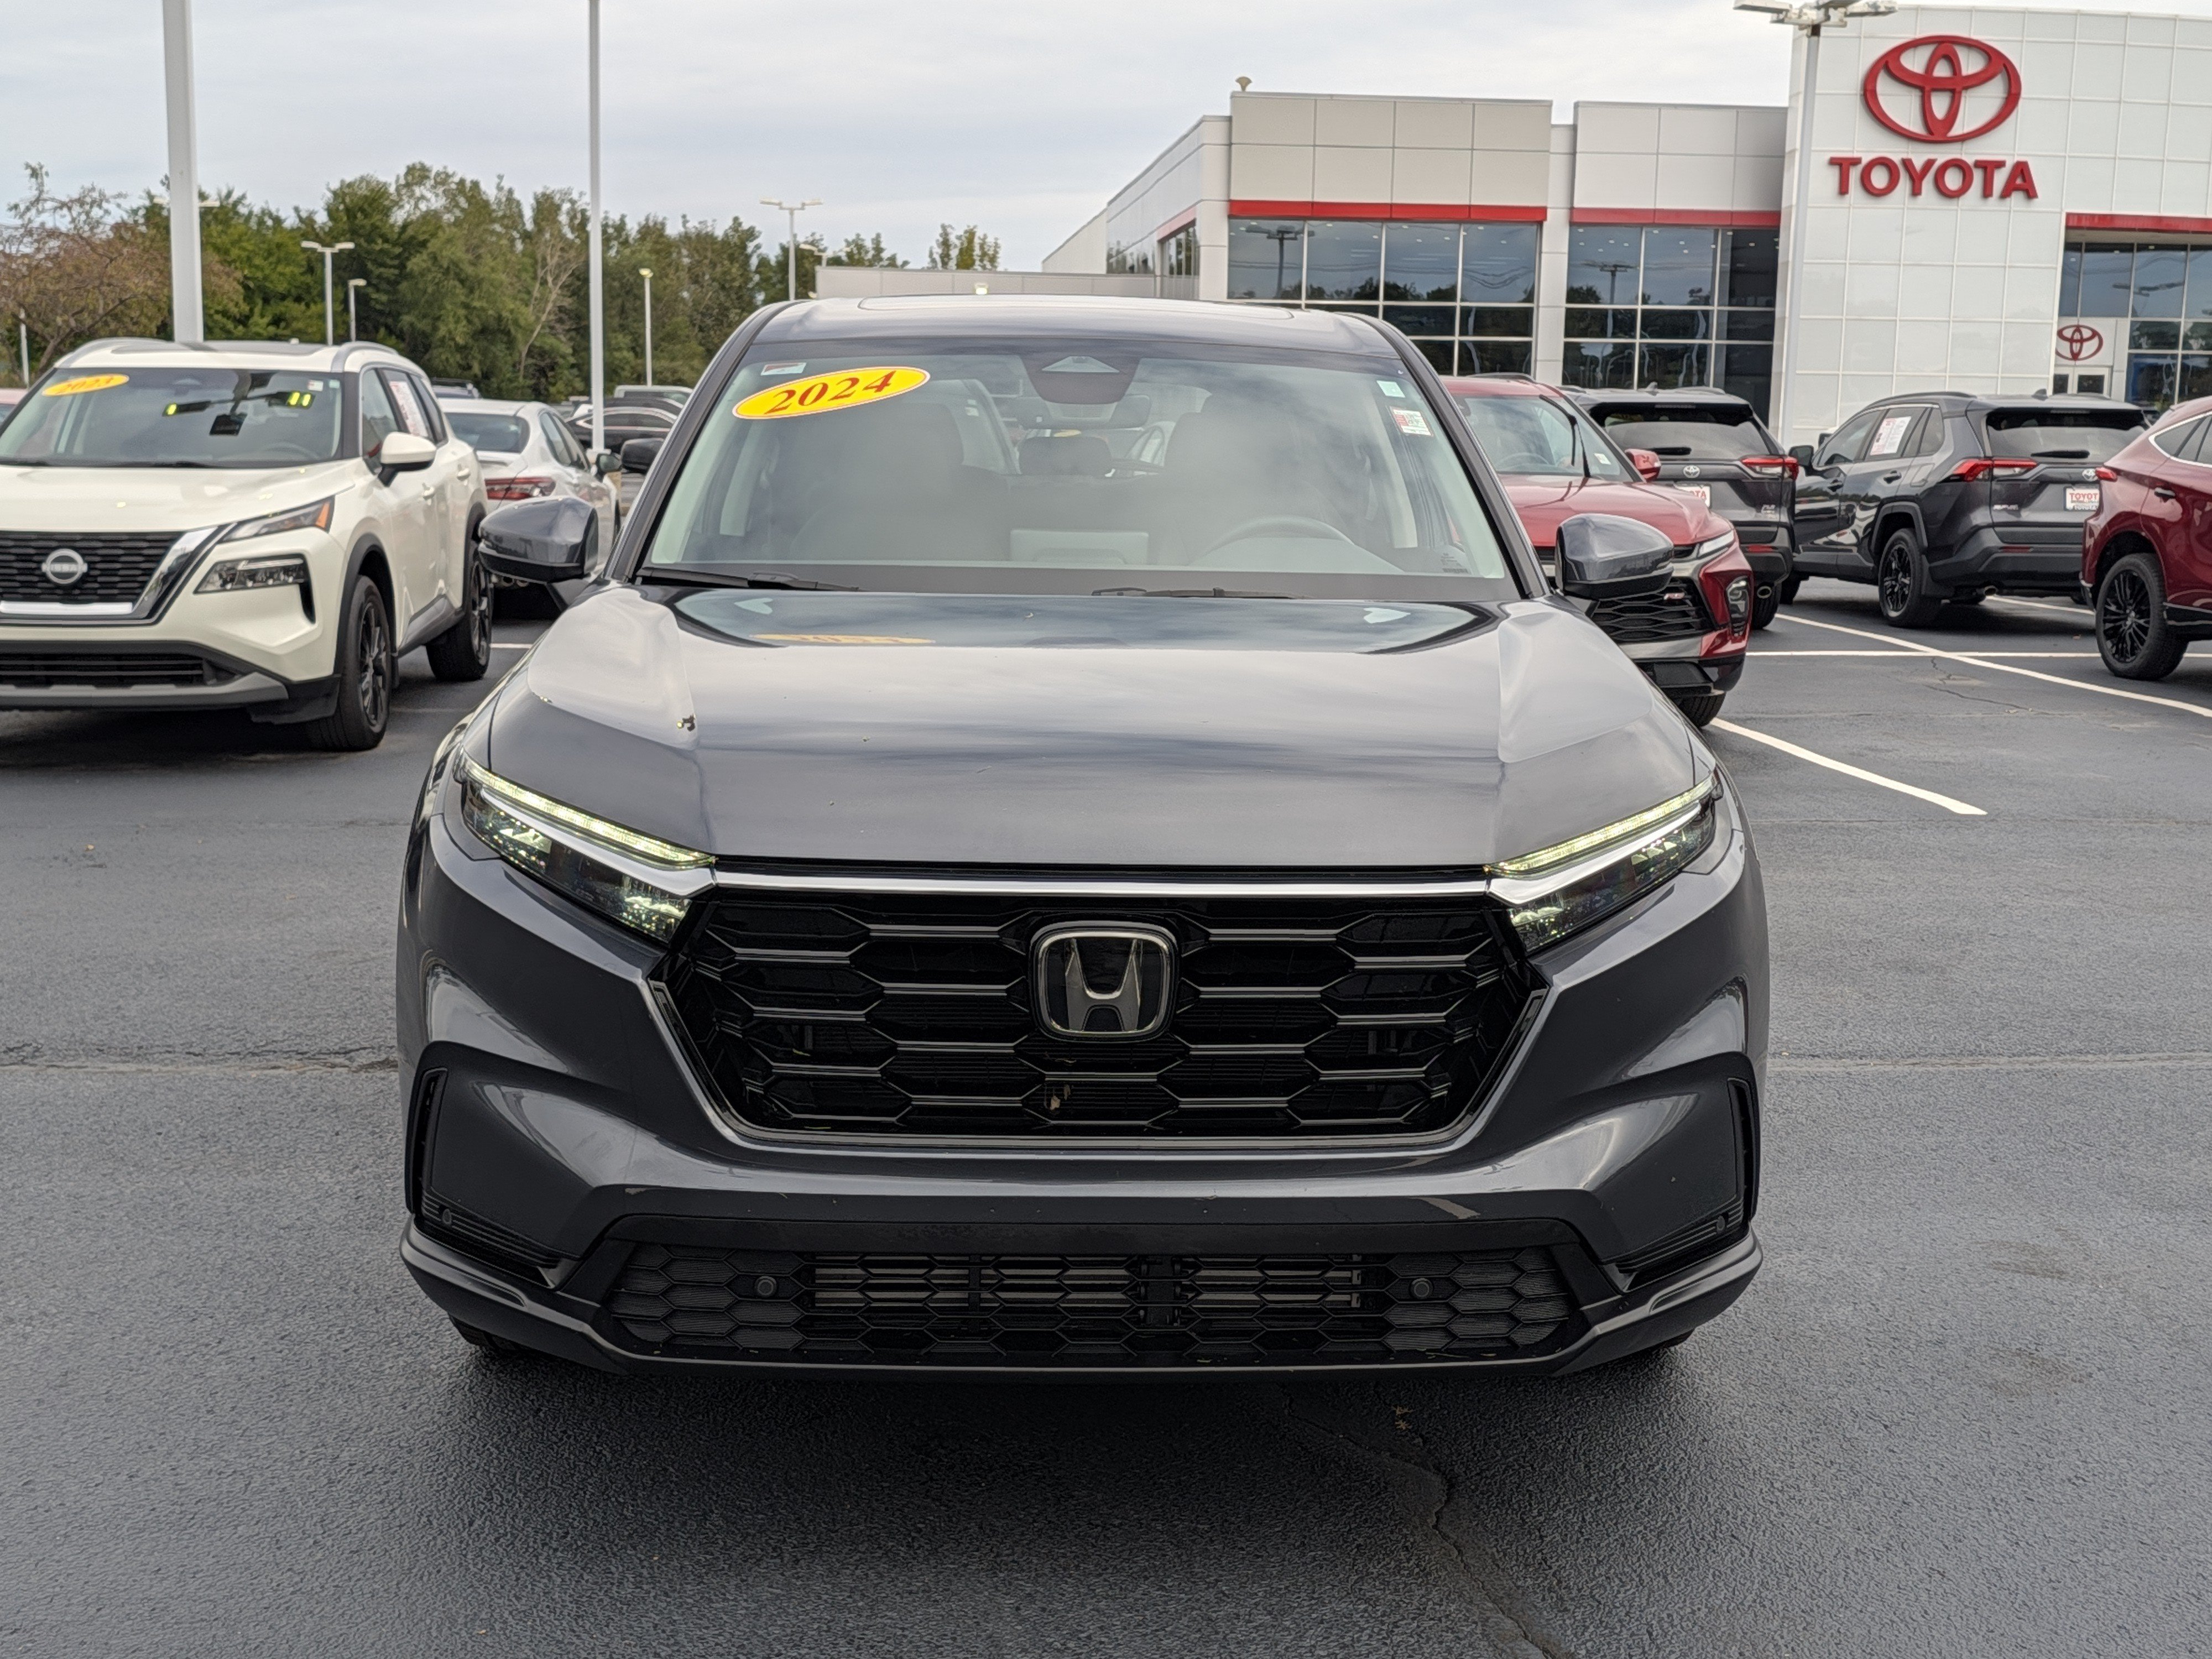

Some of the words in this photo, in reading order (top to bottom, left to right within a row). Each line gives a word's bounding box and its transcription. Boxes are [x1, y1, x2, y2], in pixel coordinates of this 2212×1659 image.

[1829, 156, 2039, 199] TOYOTA
[764, 370, 896, 415] 2024
[2069, 492, 2099, 500] TOYOT
